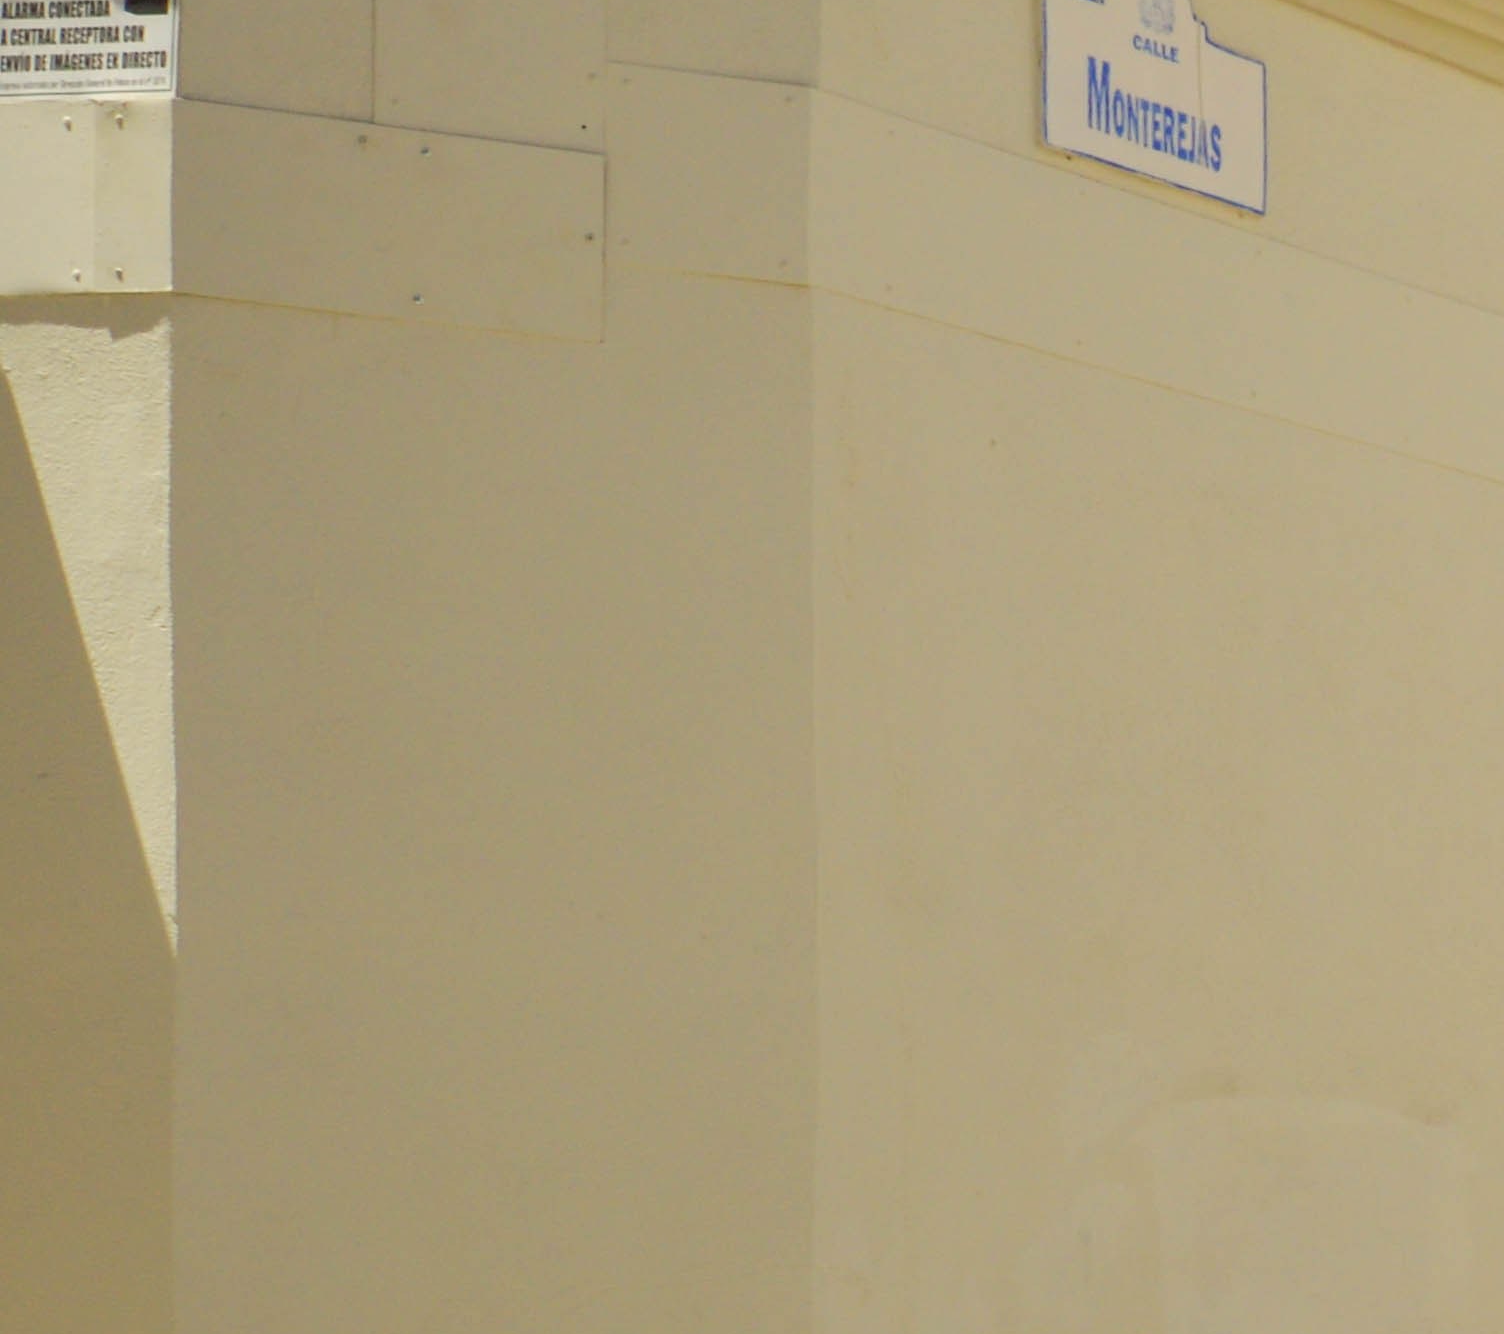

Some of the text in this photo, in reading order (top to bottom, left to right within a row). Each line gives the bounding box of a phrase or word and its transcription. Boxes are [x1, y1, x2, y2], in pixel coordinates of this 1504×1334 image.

[2, 0, 112, 18] ALARMA CONECTADA
[1, 24, 145, 45] A CENTRAL RECEPTORA CON
[1132, 34, 1180, 64] CALLE
[0, 50, 166, 72] ENVÍO DE IMÁGENES EN DIRECTO
